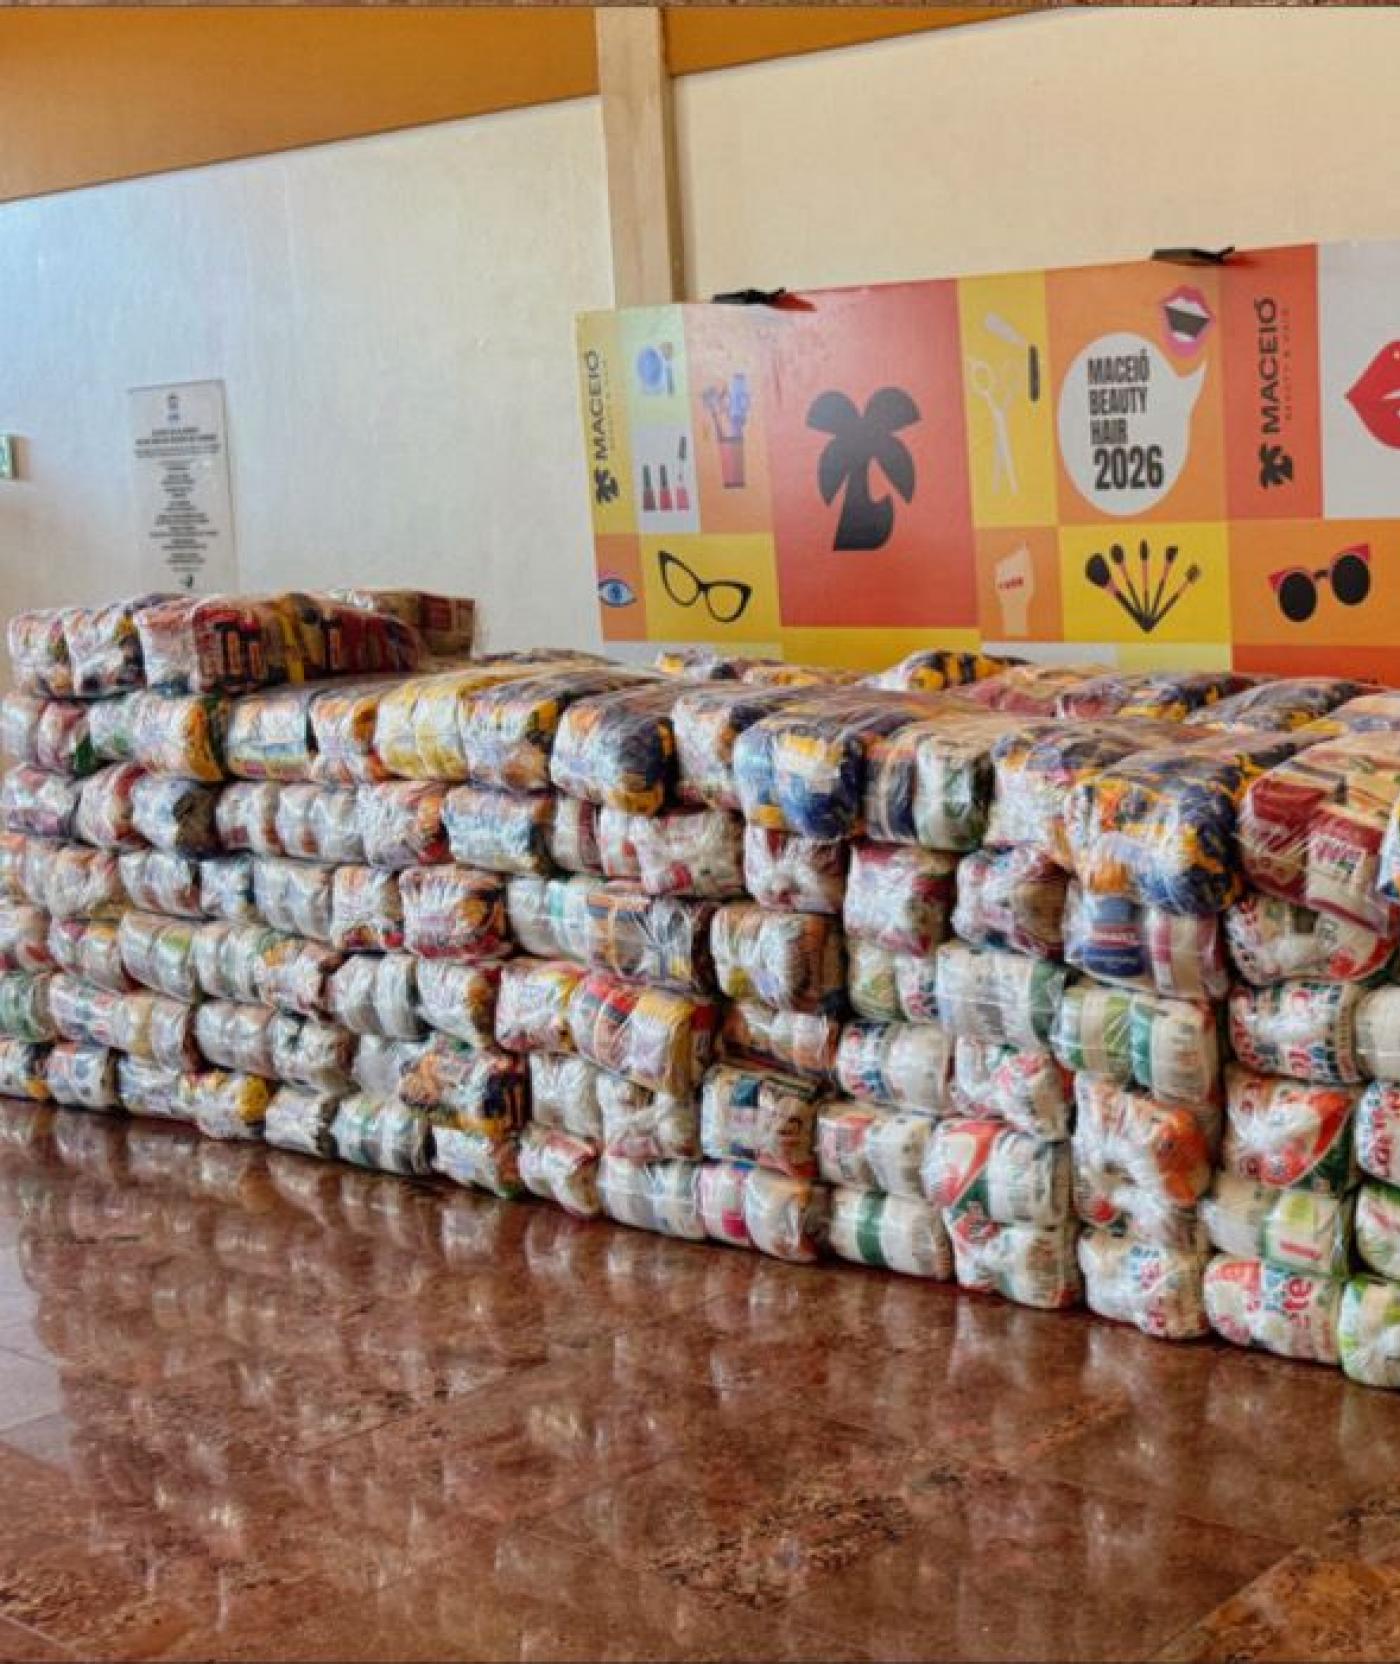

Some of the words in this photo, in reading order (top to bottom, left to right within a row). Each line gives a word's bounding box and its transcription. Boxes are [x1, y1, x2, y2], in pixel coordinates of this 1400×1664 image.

[1087, 348, 1151, 385] MACEIÓ
[1253, 298, 1281, 434] MACEIÓ
[1089, 387, 1148, 415] BEAUTY
[1090, 418, 1129, 445] HAIR
[1094, 445, 1164, 491] 2026
